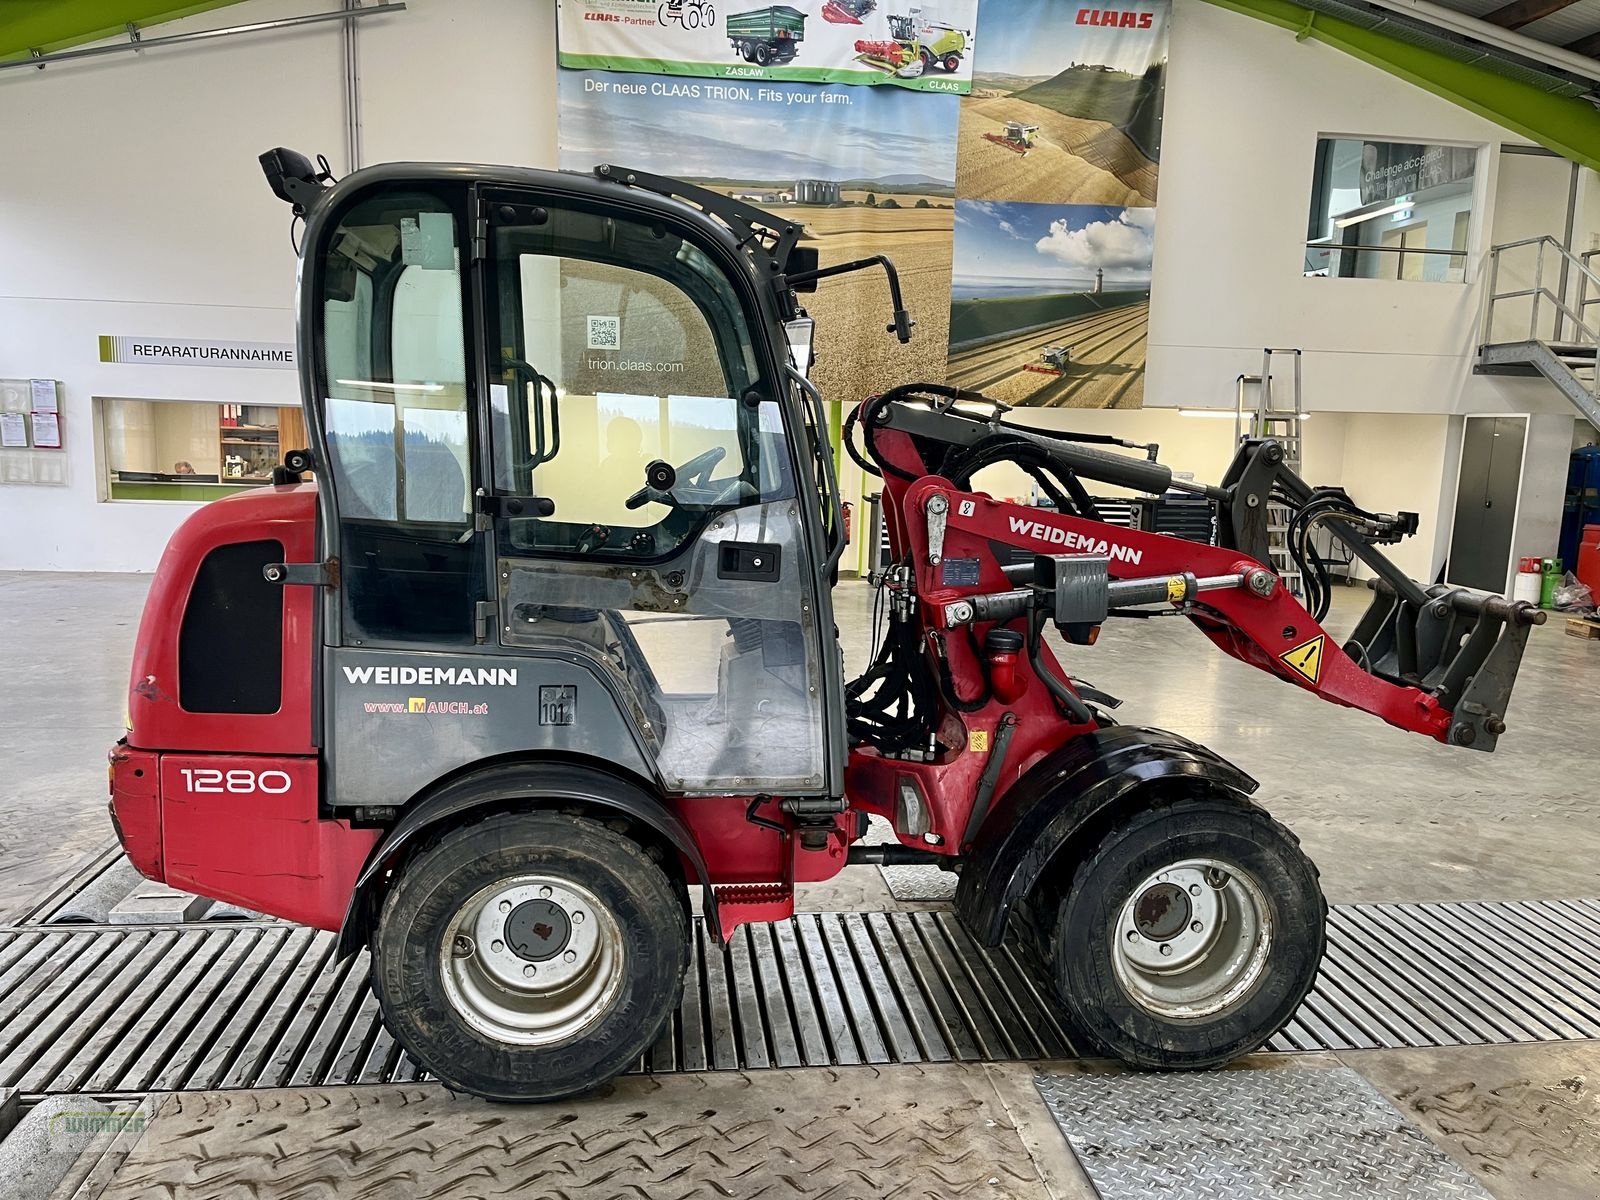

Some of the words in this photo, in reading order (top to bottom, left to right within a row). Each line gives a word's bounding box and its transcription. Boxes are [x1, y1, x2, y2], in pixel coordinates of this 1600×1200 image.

[1075, 9, 1154, 29] CLAAS
[725, 67, 764, 77] ZASLAW
[584, 79, 609, 92] Der
[613, 83, 647, 95] neue
[651, 82, 700, 98] CLAAS
[704, 85, 753, 101] TRION.
[758, 89, 783, 102] Fits
[786, 92, 817, 105] your
[820, 91, 853, 105] farm.
[929, 81, 959, 91] CLAAS
[1365, 163, 1402, 182] Challenge
[1404, 148, 1444, 169] accepted.
[1405, 172, 1417, 183] von
[1419, 164, 1442, 180] CLAAS
[133, 344, 293, 362] REPARATURANNAHME
[588, 358, 684, 372] trion.claas.com
[1008, 516, 1143, 565] WEIDEMANN
[342, 666, 517, 686] WEIDEMANN
[364, 697, 488, 715] www.MAUCH.at
[543, 703, 563, 723] 101
[180, 769, 292, 794] 1280
